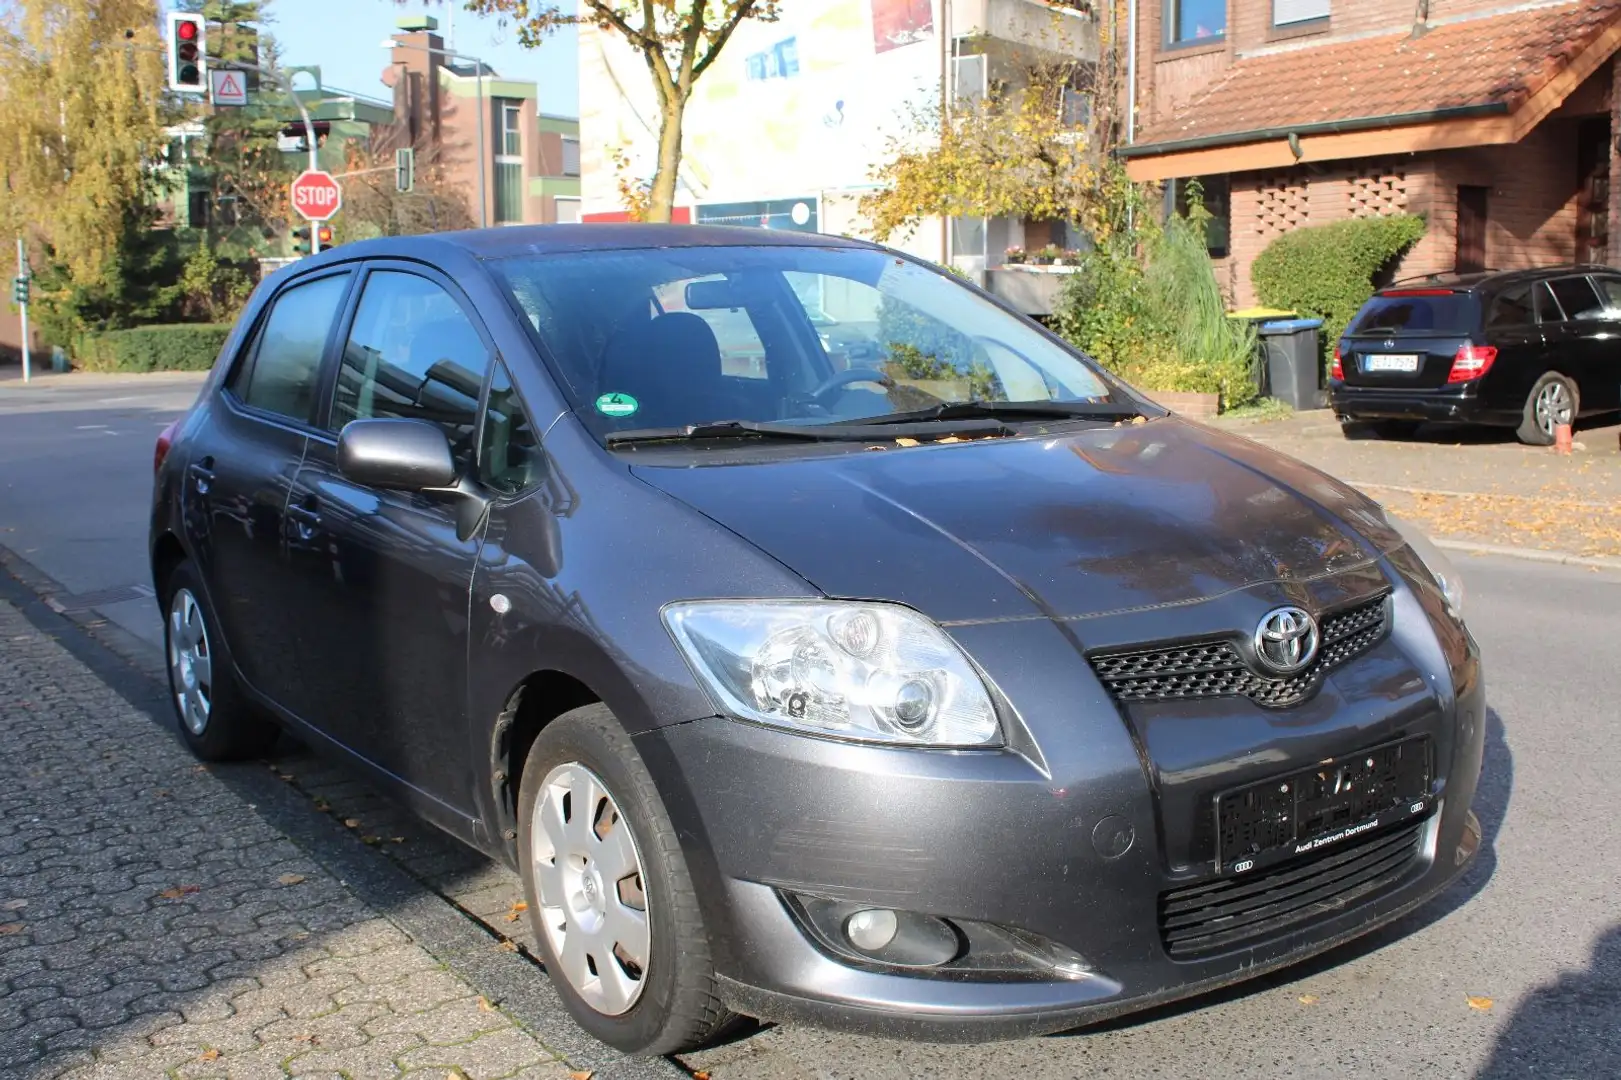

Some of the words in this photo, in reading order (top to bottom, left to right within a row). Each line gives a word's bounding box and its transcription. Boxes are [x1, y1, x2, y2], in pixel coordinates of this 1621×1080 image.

[297, 186, 337, 205] STOP
[611, 394, 623, 404] 4
[1295, 842, 1312, 853] Audi
[1313, 832, 1344, 847] Zentrum
[1345, 819, 1378, 836] Dortmund
